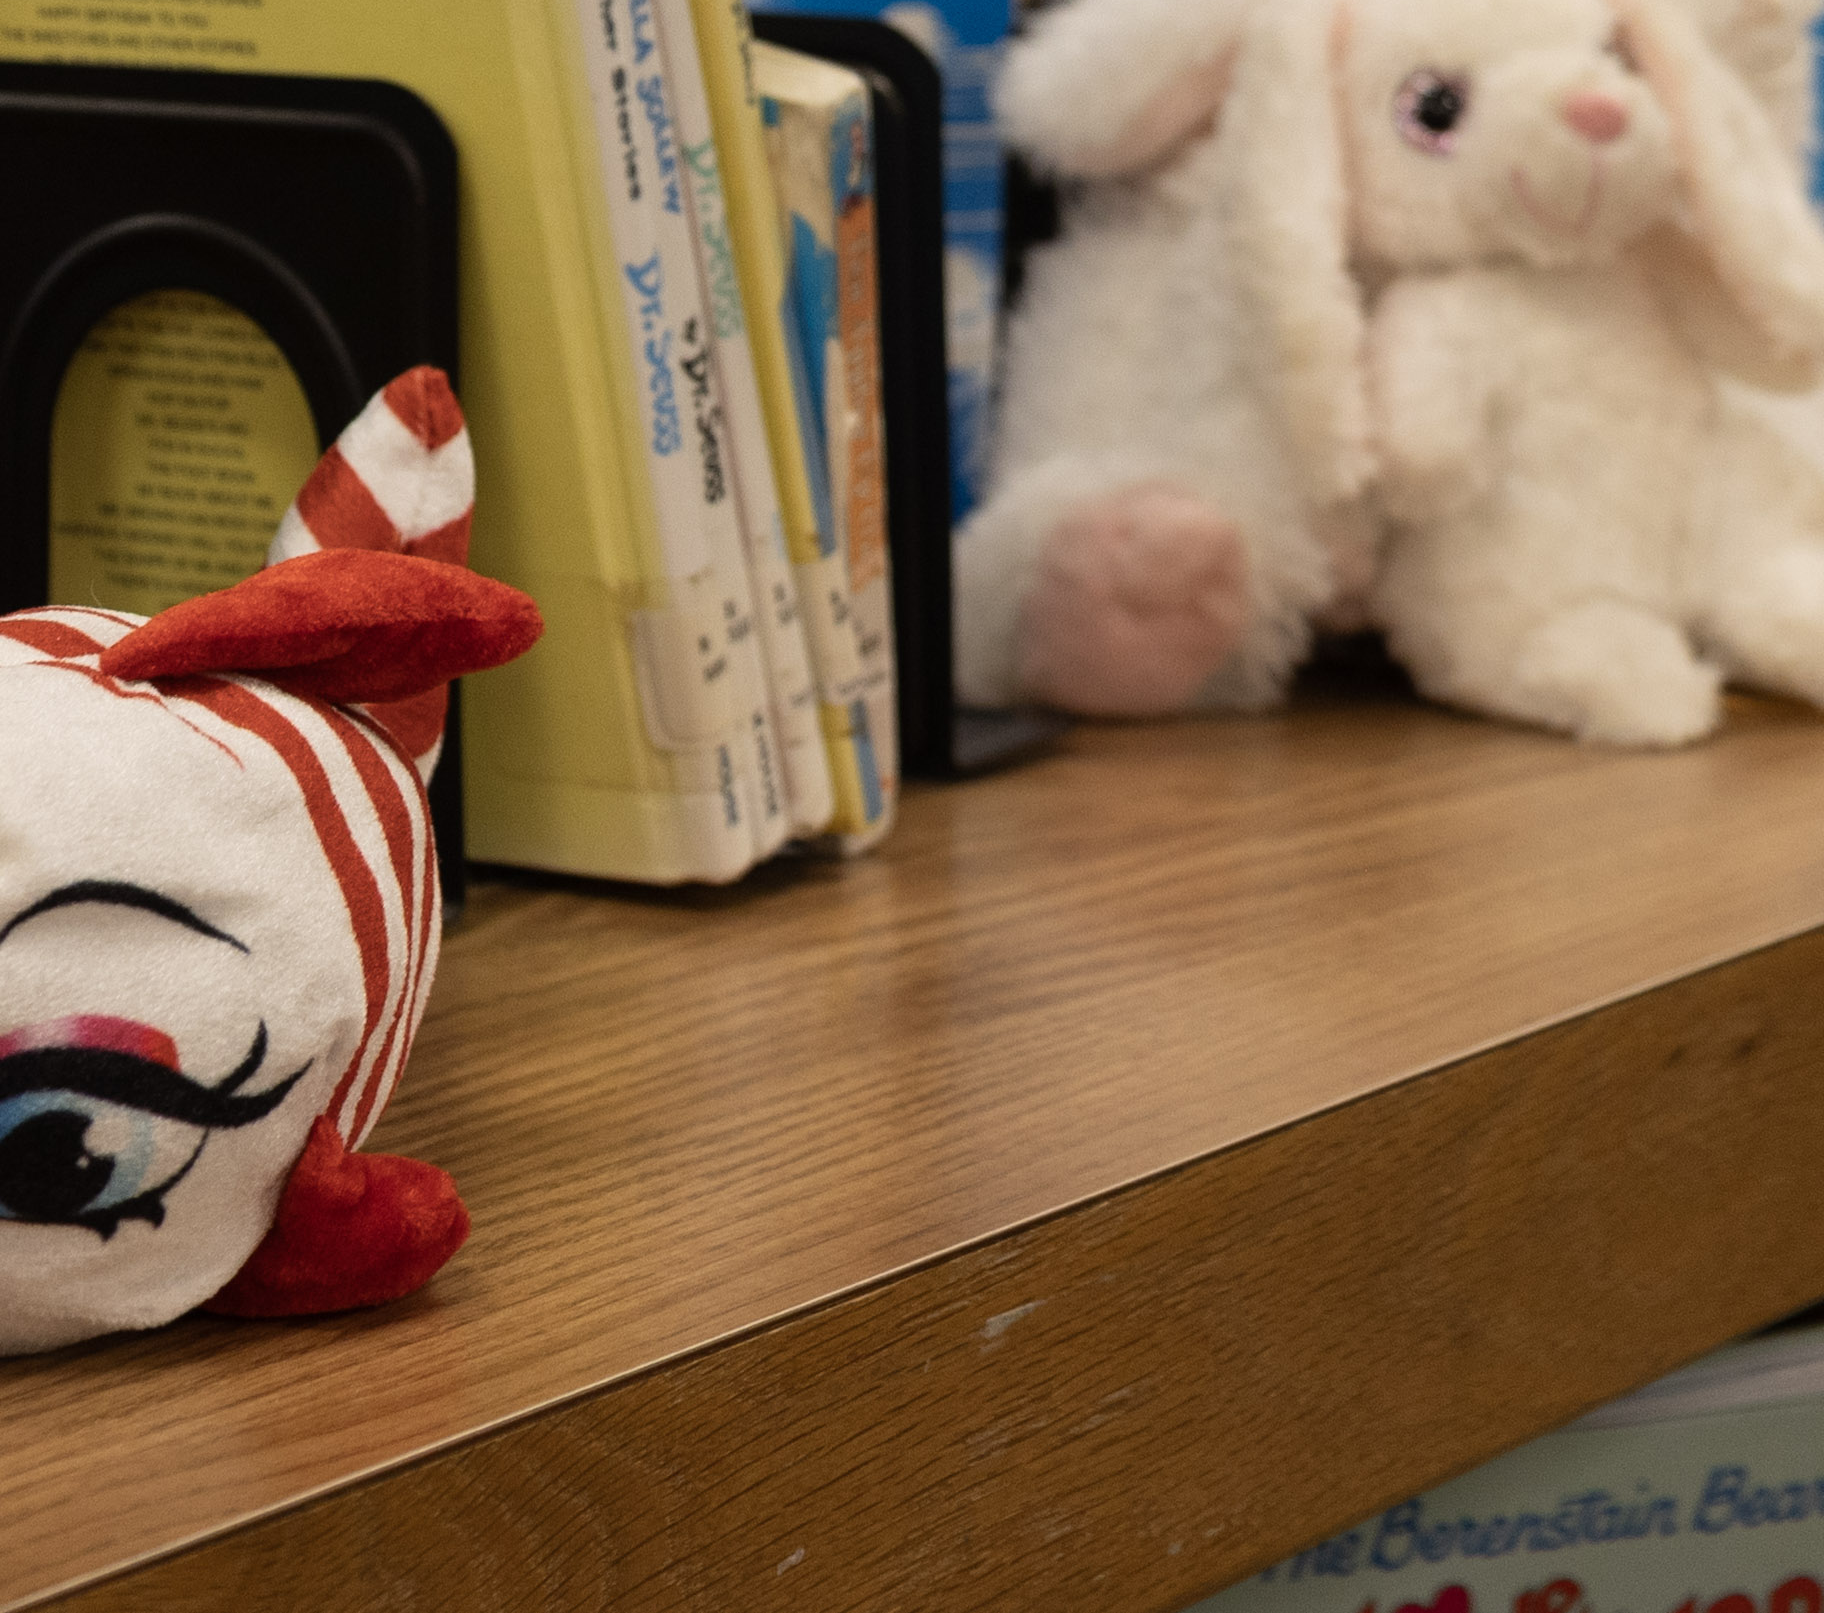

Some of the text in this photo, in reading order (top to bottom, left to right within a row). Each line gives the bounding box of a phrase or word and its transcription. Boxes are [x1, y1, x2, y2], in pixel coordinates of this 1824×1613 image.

[622, 249, 684, 458] Dr. Seuss
[691, 402, 726, 508] Seuss
[1370, 1480, 1684, 1573] Berenstain
